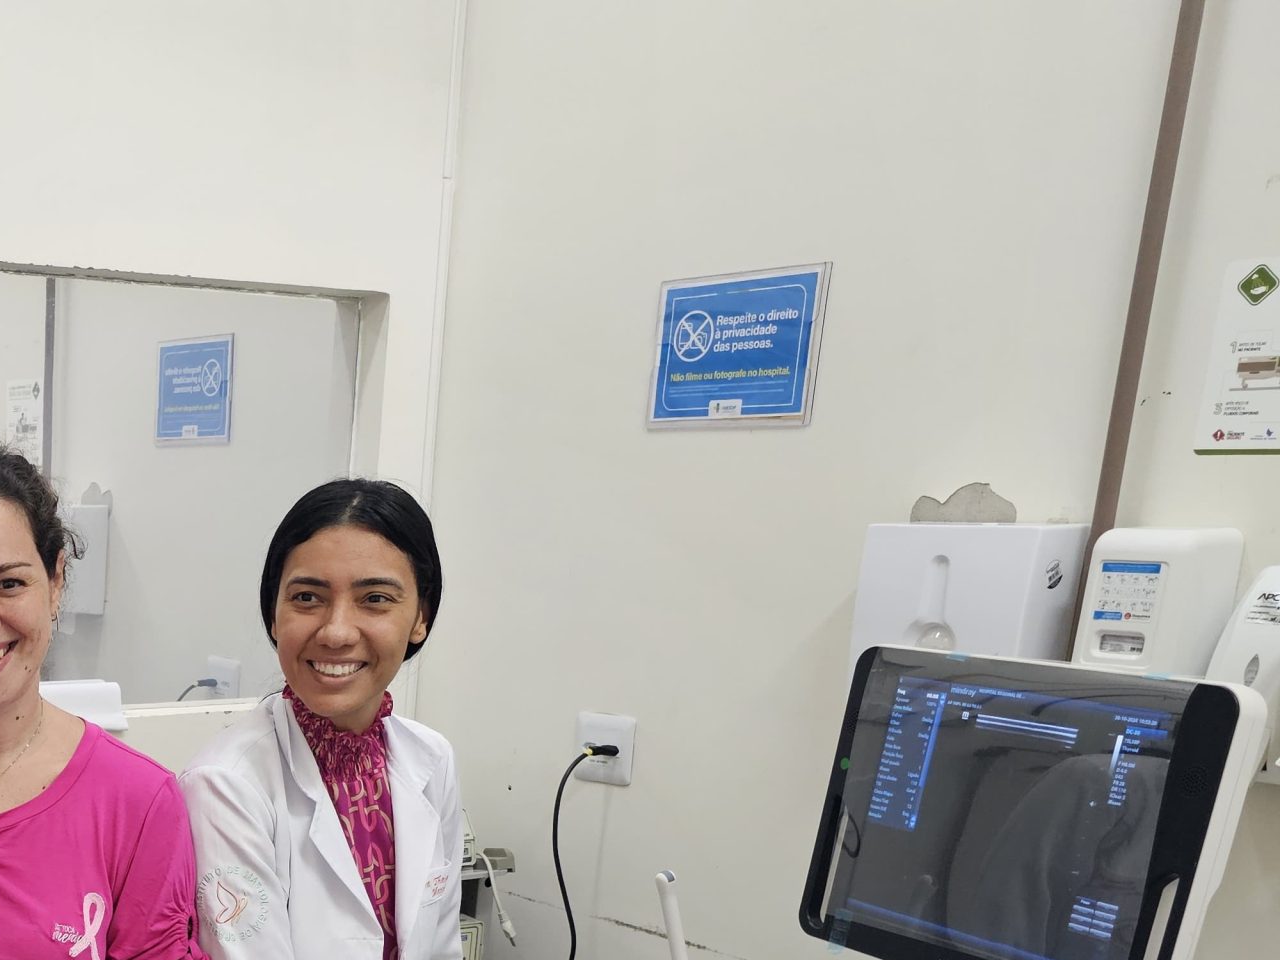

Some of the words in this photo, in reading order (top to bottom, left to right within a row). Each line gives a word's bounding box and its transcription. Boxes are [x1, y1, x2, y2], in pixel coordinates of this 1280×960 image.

[716, 313, 757, 328] Respeite
[758, 313, 765, 321] o
[767, 308, 799, 321] direito
[714, 328, 721, 339] à
[722, 324, 778, 340] privacidade
[713, 341, 730, 353] das
[731, 340, 774, 353] pessoas.
[670, 371, 684, 382] Não
[685, 372, 702, 381] filme
[704, 373, 713, 381] ou
[714, 370, 746, 382] fotografe
[747, 369, 757, 378] no
[950, 686, 976, 697] mindray
